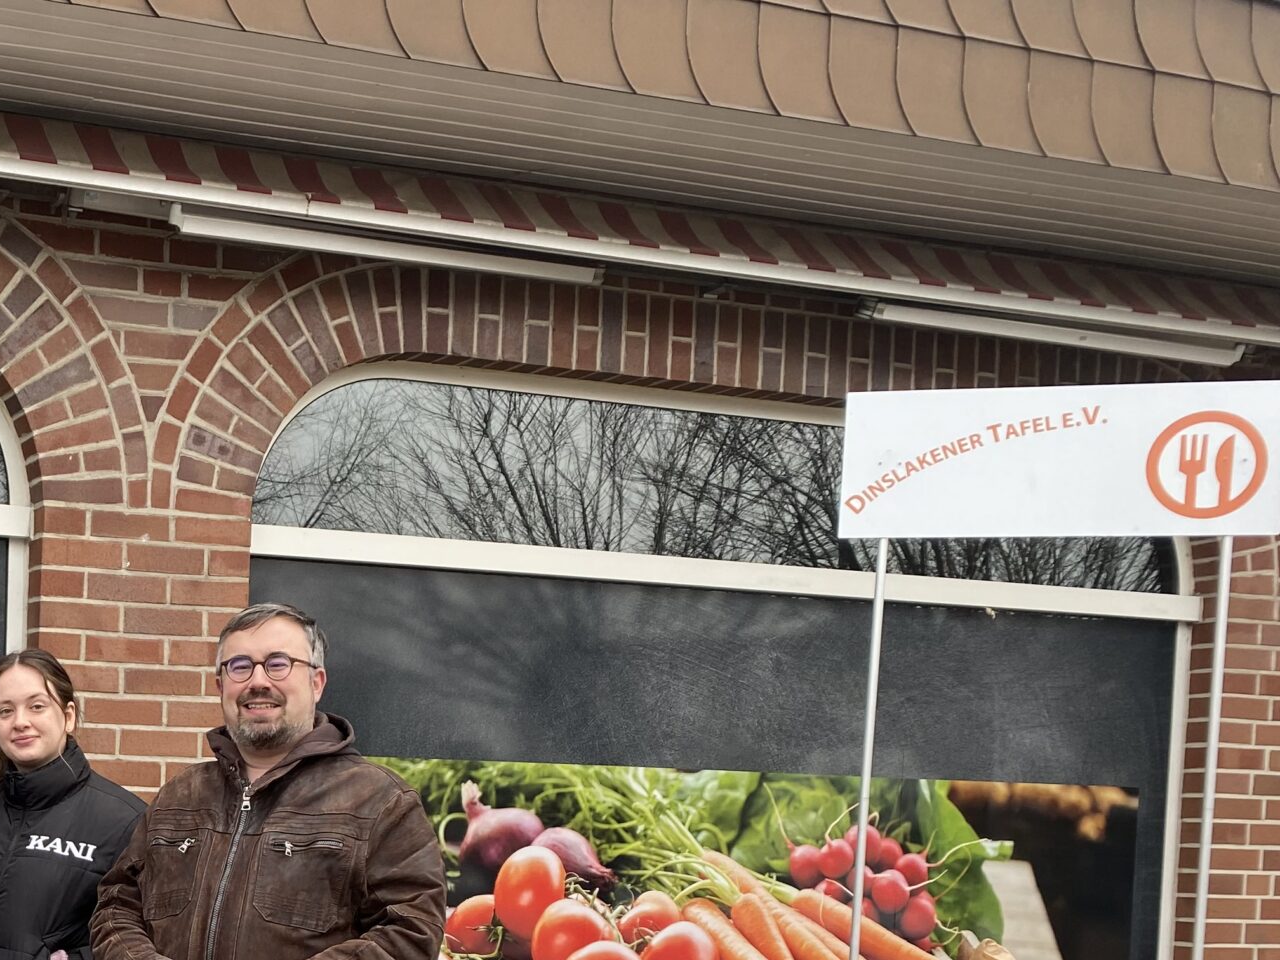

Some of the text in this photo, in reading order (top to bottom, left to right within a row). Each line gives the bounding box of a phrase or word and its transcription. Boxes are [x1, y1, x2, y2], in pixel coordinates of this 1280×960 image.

[844, 405, 1109, 516] DINSLAKENER TAFEL E.V.
[25, 834, 97, 862] KANI
